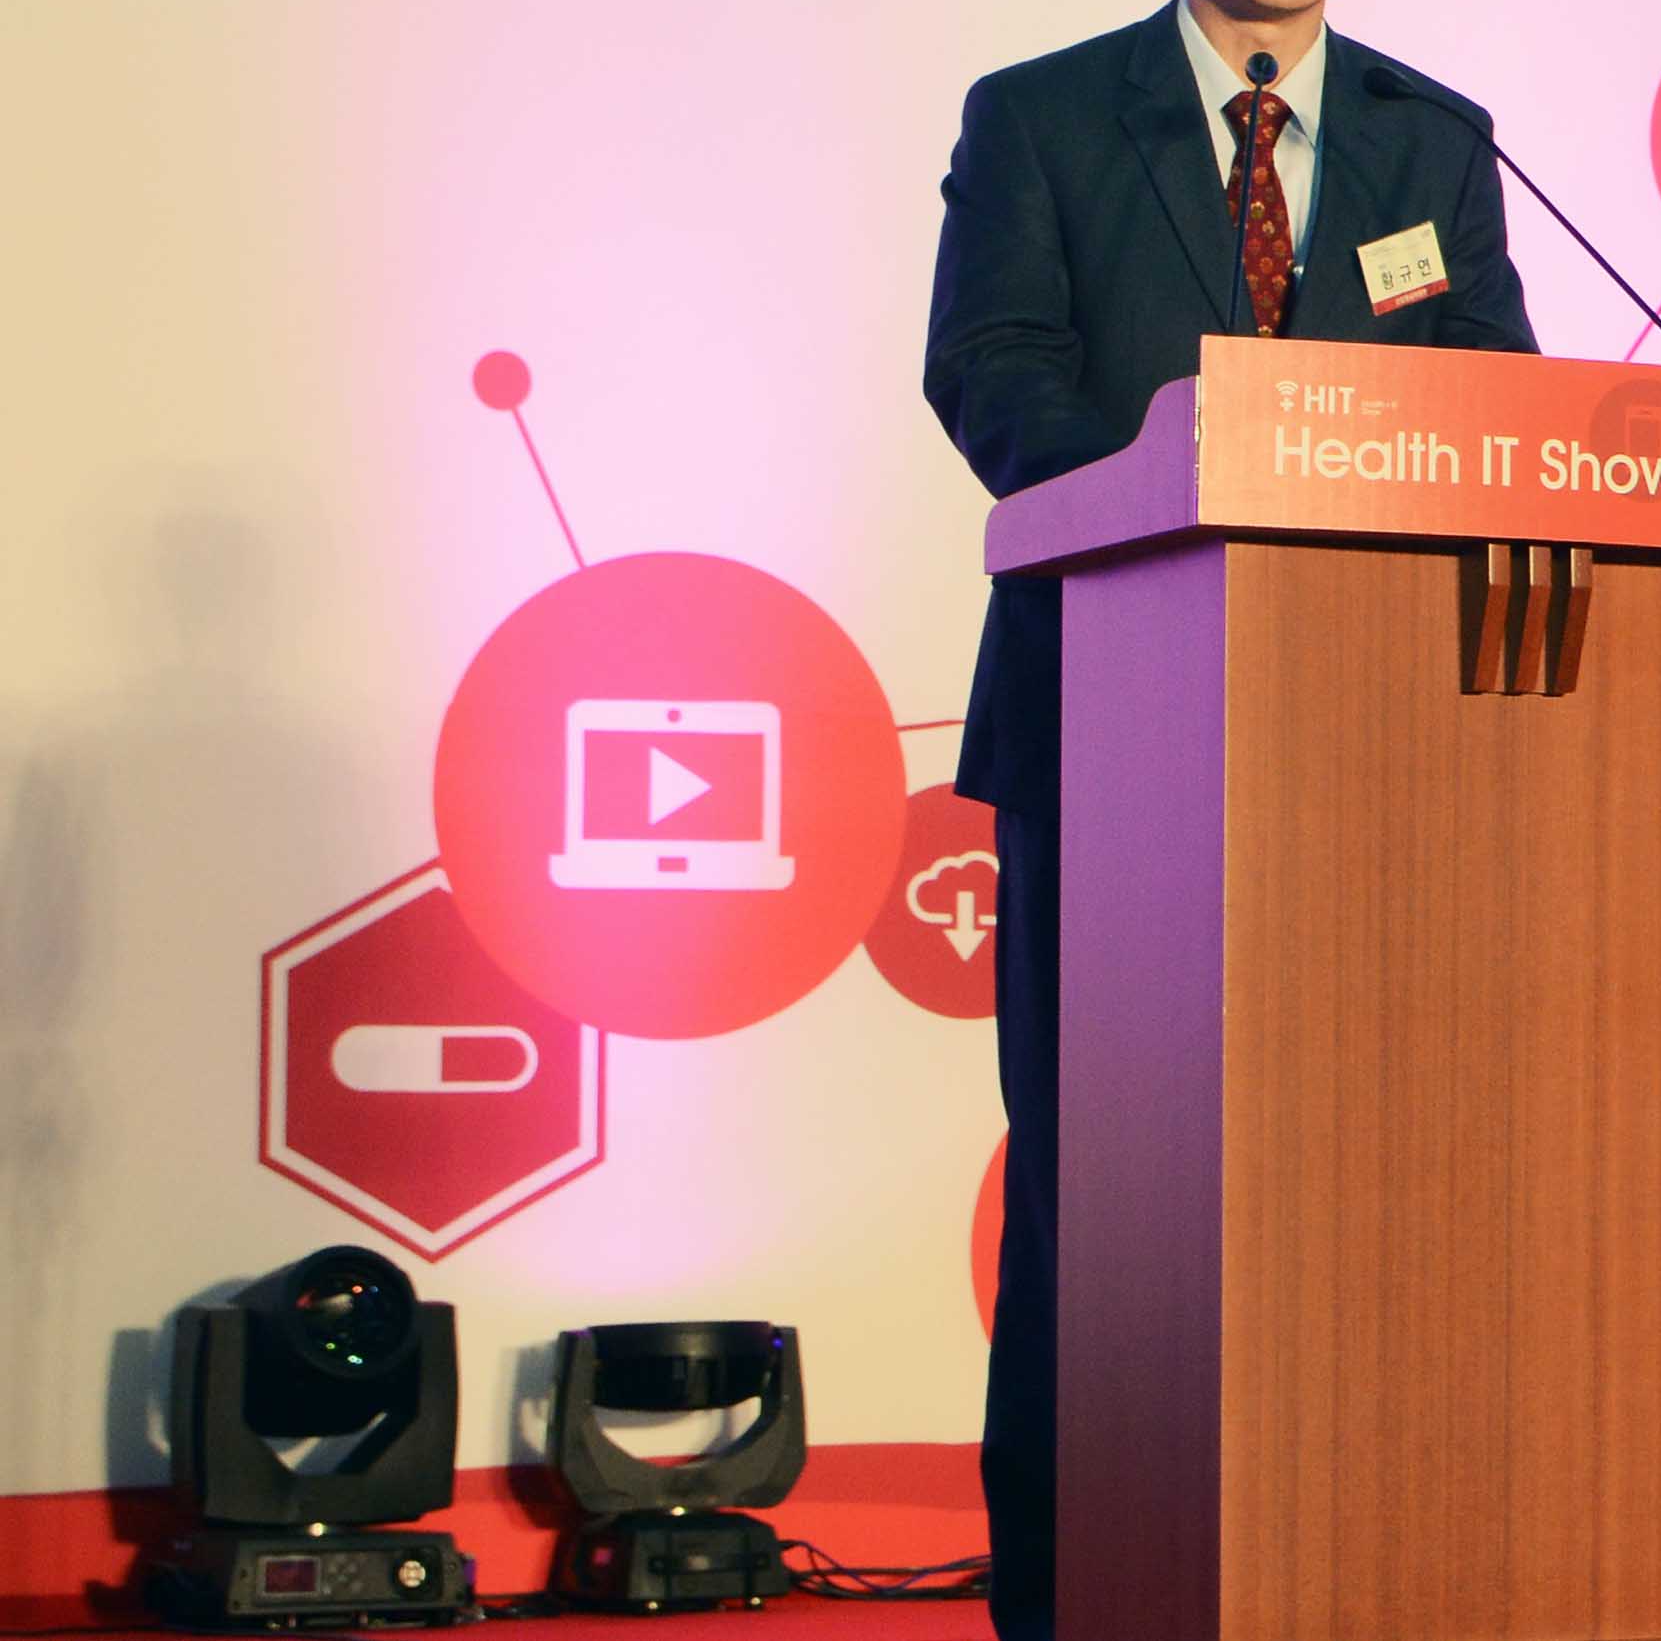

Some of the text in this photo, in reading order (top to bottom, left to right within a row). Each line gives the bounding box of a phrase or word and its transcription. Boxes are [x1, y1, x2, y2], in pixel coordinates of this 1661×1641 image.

[1304, 384, 1355, 415] HIT
[1274, 425, 1460, 485] Health
[1482, 435, 1520, 487] IT
